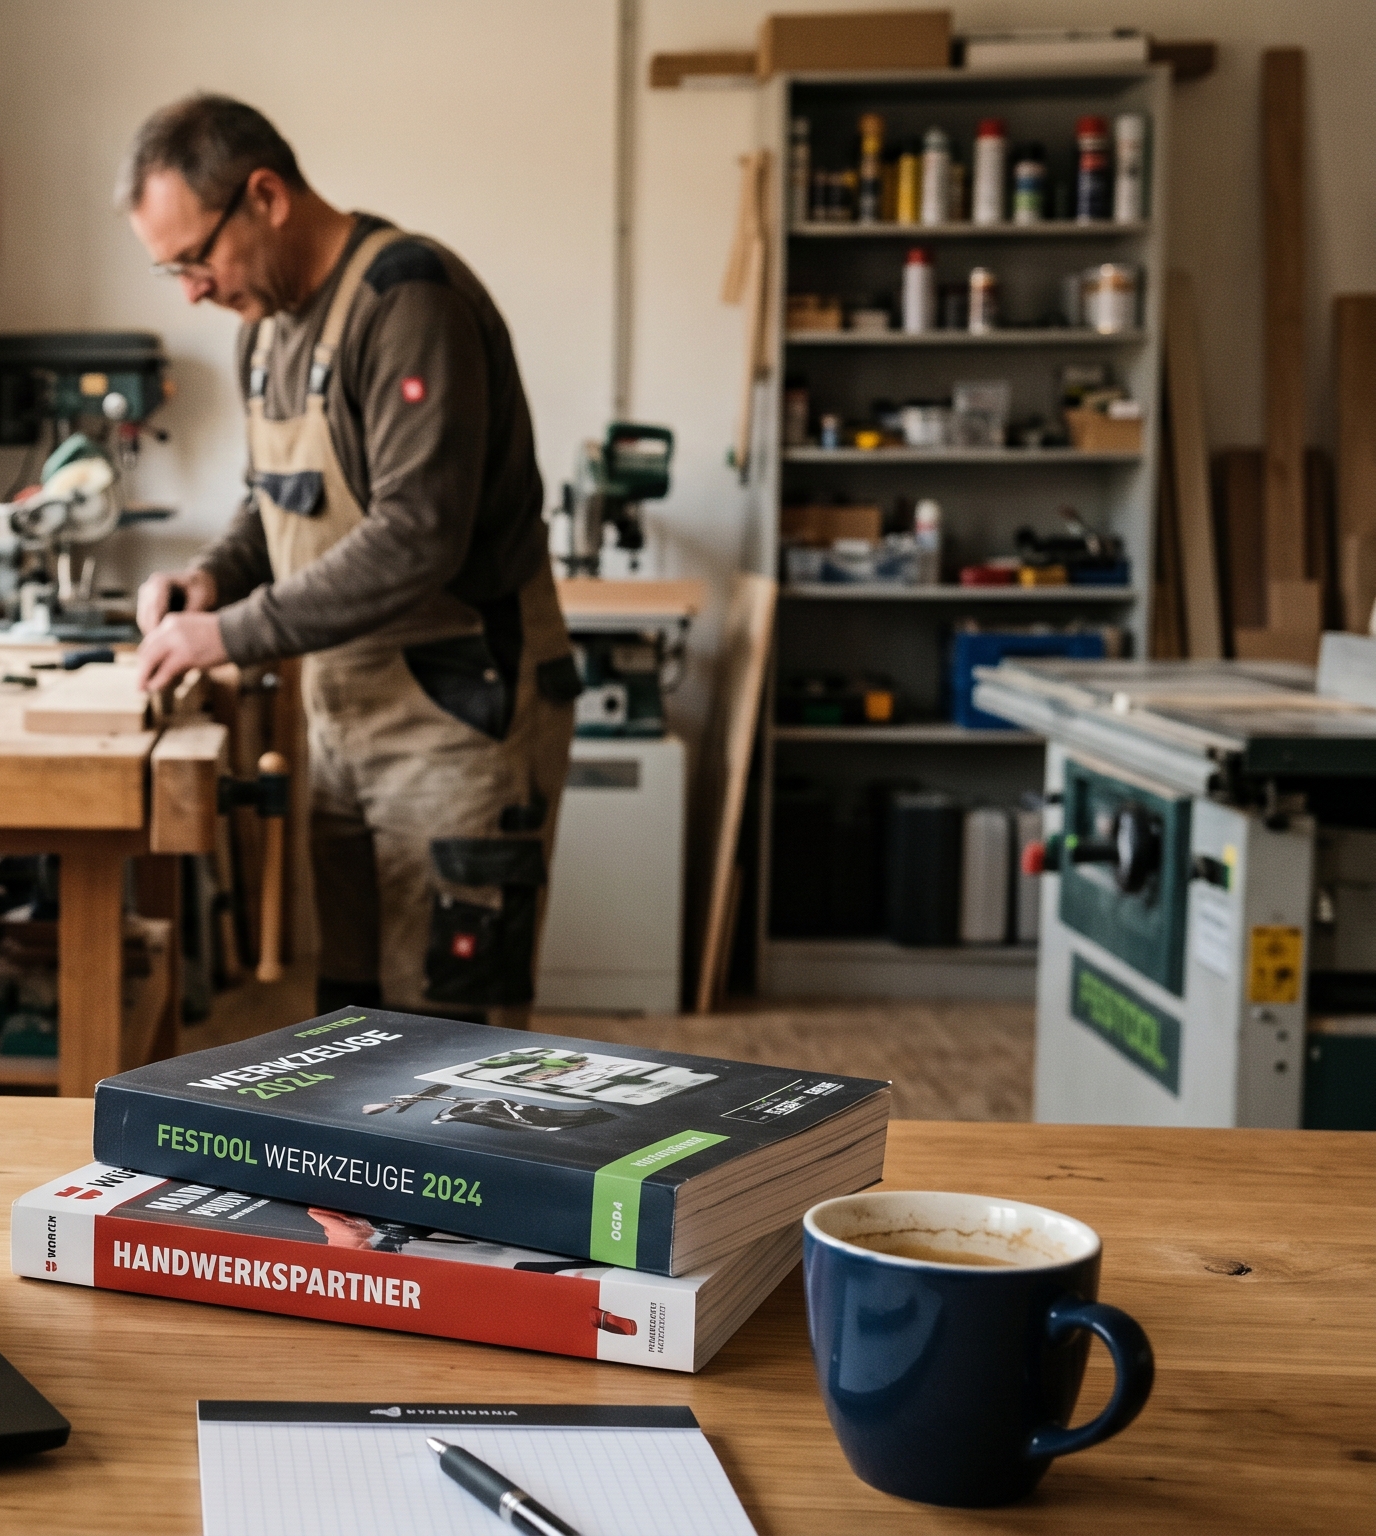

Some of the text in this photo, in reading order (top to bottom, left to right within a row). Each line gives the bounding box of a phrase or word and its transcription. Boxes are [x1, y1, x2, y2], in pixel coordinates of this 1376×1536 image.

[237, 1070, 335, 1101] 2024
[157, 1123, 483, 1207] FESTOOL WERKZEUGE 2024
[113, 1241, 421, 1310] HANDWERKSPARTNER
